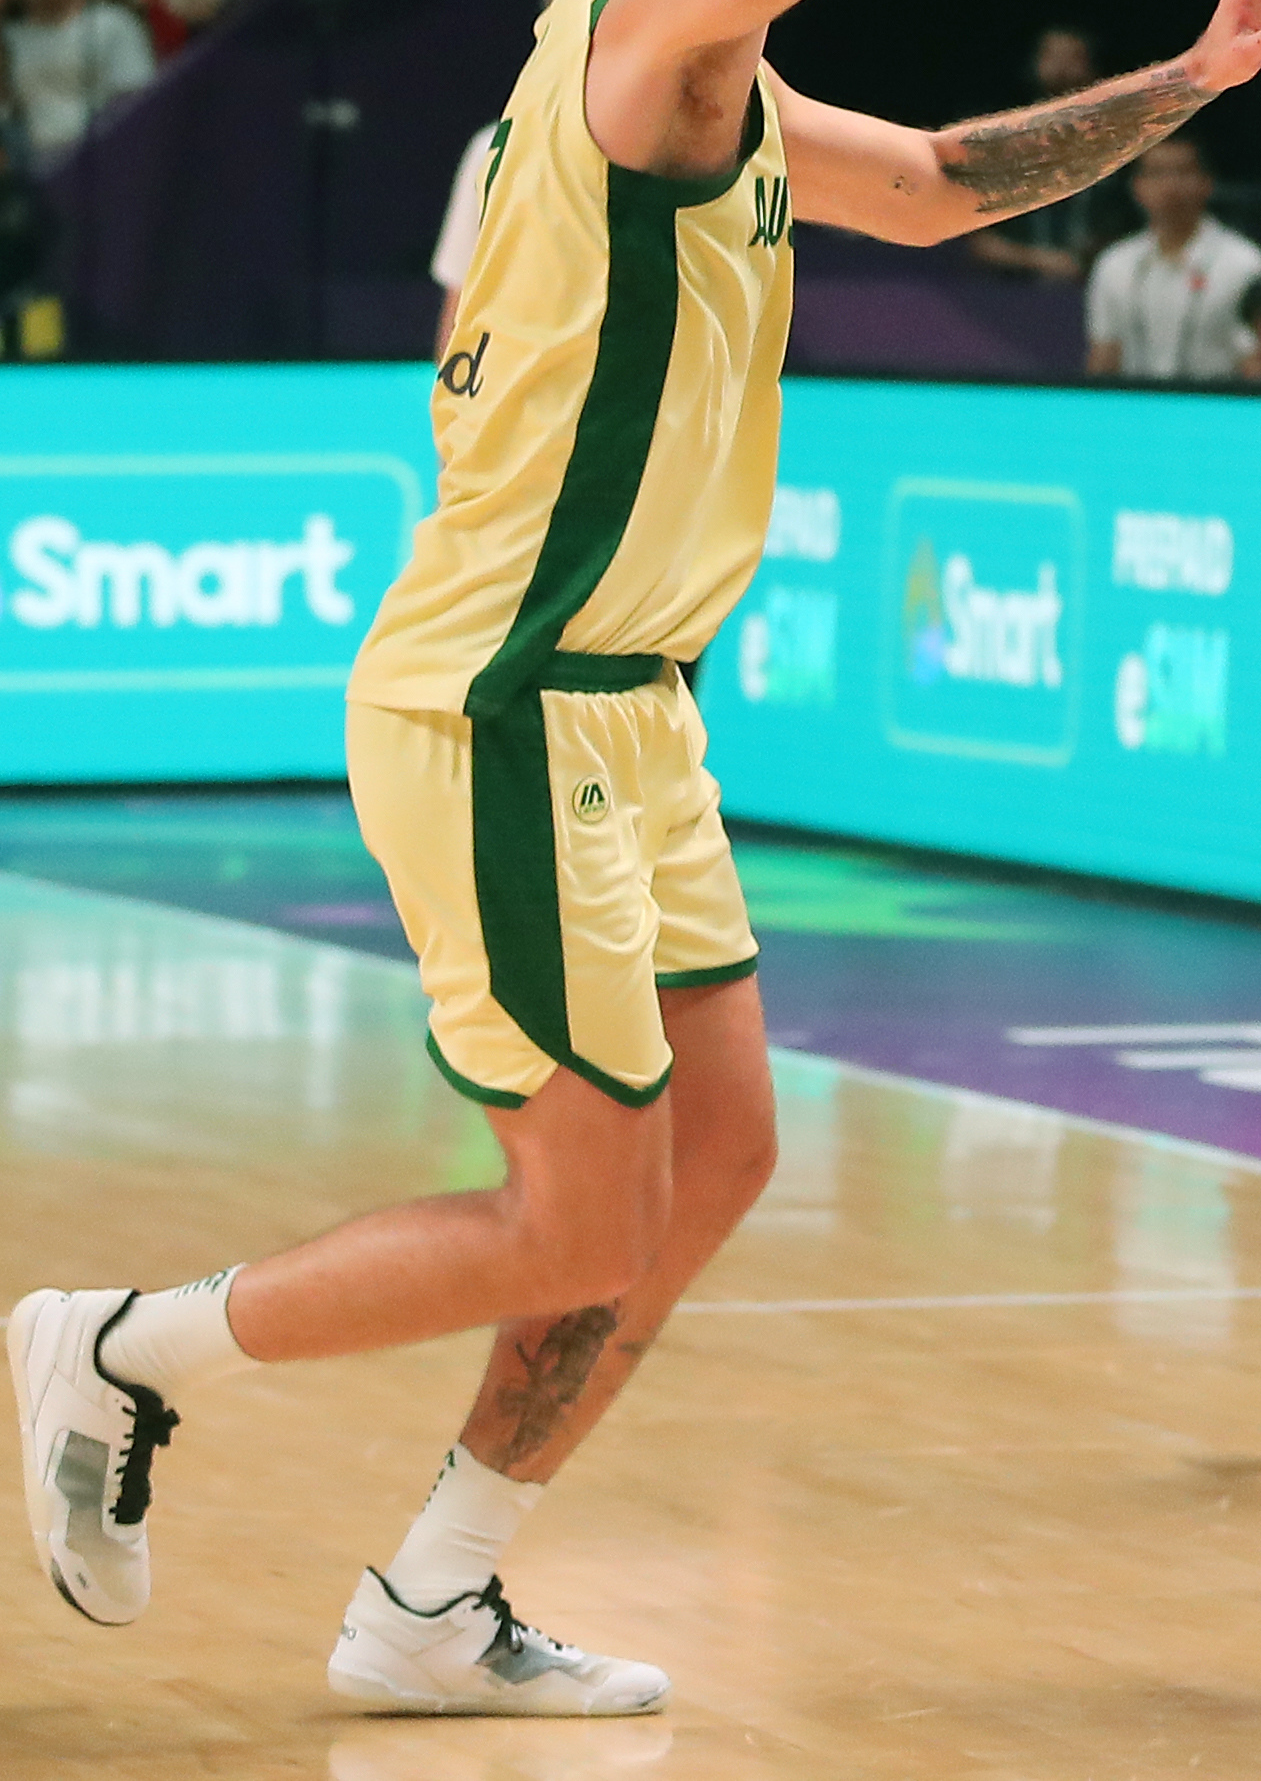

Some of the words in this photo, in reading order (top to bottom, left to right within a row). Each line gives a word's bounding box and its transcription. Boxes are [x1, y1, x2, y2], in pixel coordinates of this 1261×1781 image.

[748, 175, 794, 249] AU
[10, 514, 354, 628] Smart
[944, 552, 1063, 688] Smart
